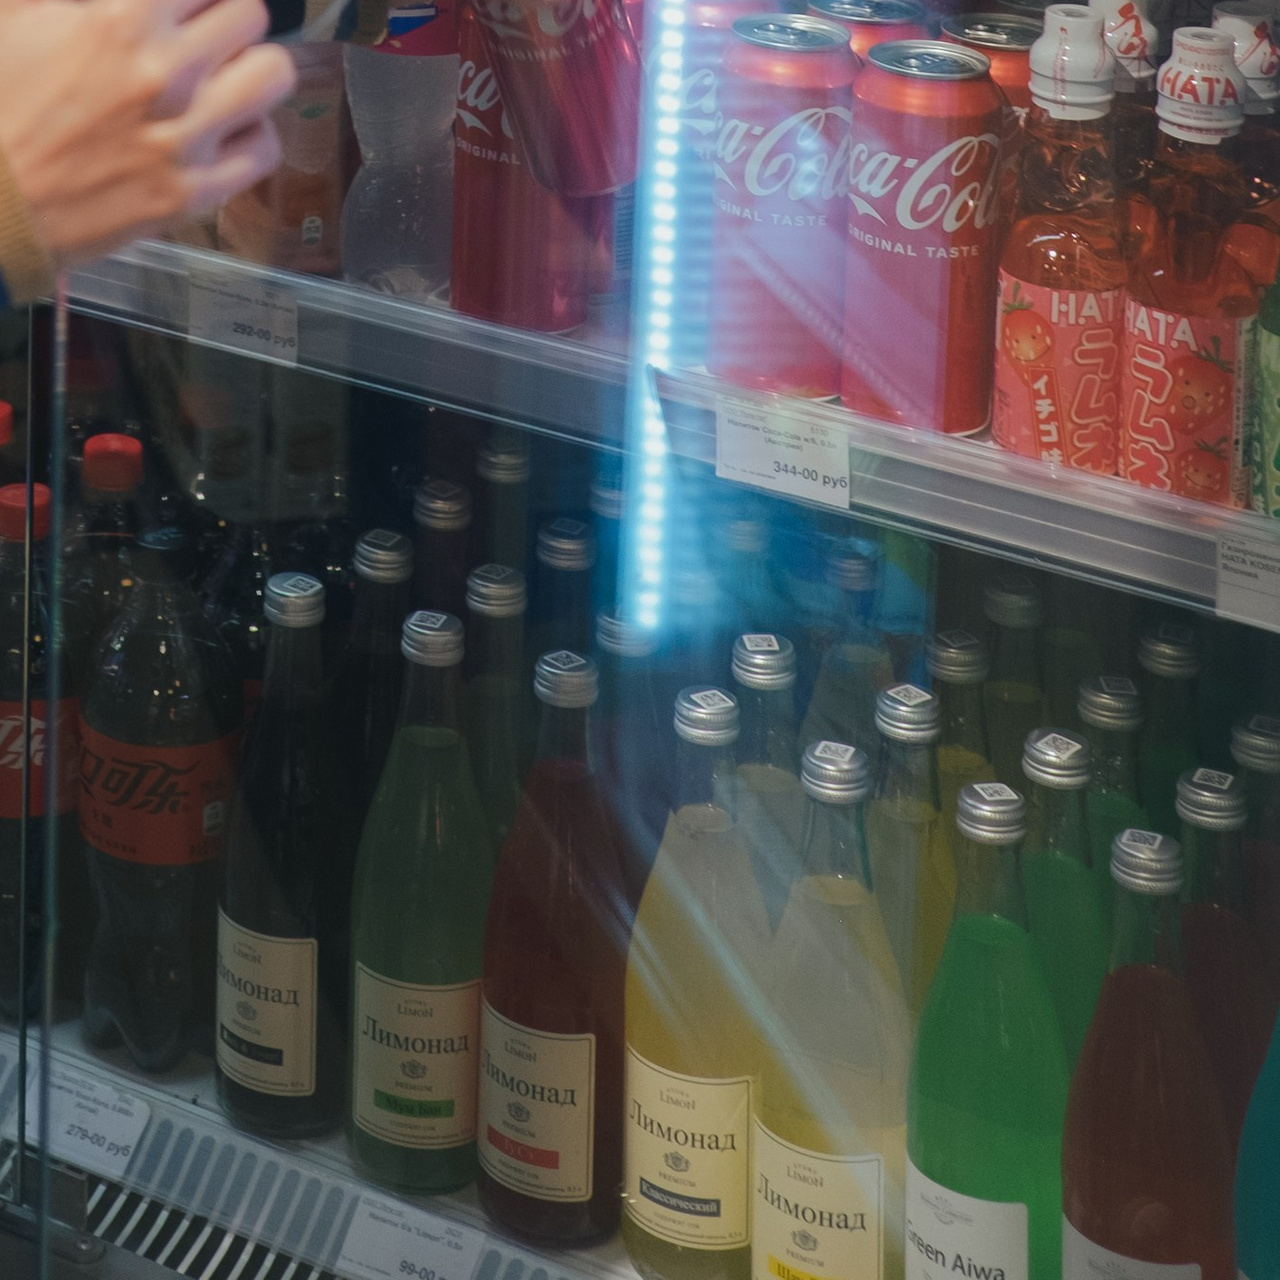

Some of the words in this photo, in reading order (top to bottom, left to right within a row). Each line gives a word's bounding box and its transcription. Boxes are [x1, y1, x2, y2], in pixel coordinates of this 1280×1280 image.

[1159, 66, 1241, 106] HATA
[771, 213, 828, 227] TASTE
[925, 243, 980, 260] TASTE
[1124, 298, 1199, 353] HATA
[727, 418, 760, 432] Напиток
[761, 425, 802, 442] Coca-Cola
[773, 460, 819, 483] 344-00
[822, 474, 849, 491] руб
[397, 1002, 434, 1019] LIMON
[362, 1014, 470, 1055] Лимонад
[504, 1041, 537, 1063] LIMON
[483, 1048, 577, 1107] Лимонад
[659, 1089, 696, 1111] LIMON
[629, 1099, 737, 1152] Лимонад
[65, 1123, 107, 1149] 279-00
[109, 1139, 132, 1157] руб
[658, 1171, 697, 1188] PREMIUM
[786, 1165, 824, 1188] LIMON
[641, 1177, 718, 1215] Классический
[757, 1173, 867, 1233] Лимонад
[398, 1259, 436, 1280] 99-00
[786, 1248, 824, 1268] PREMIUM
[951, 1251, 1007, 1280] Aiwa
